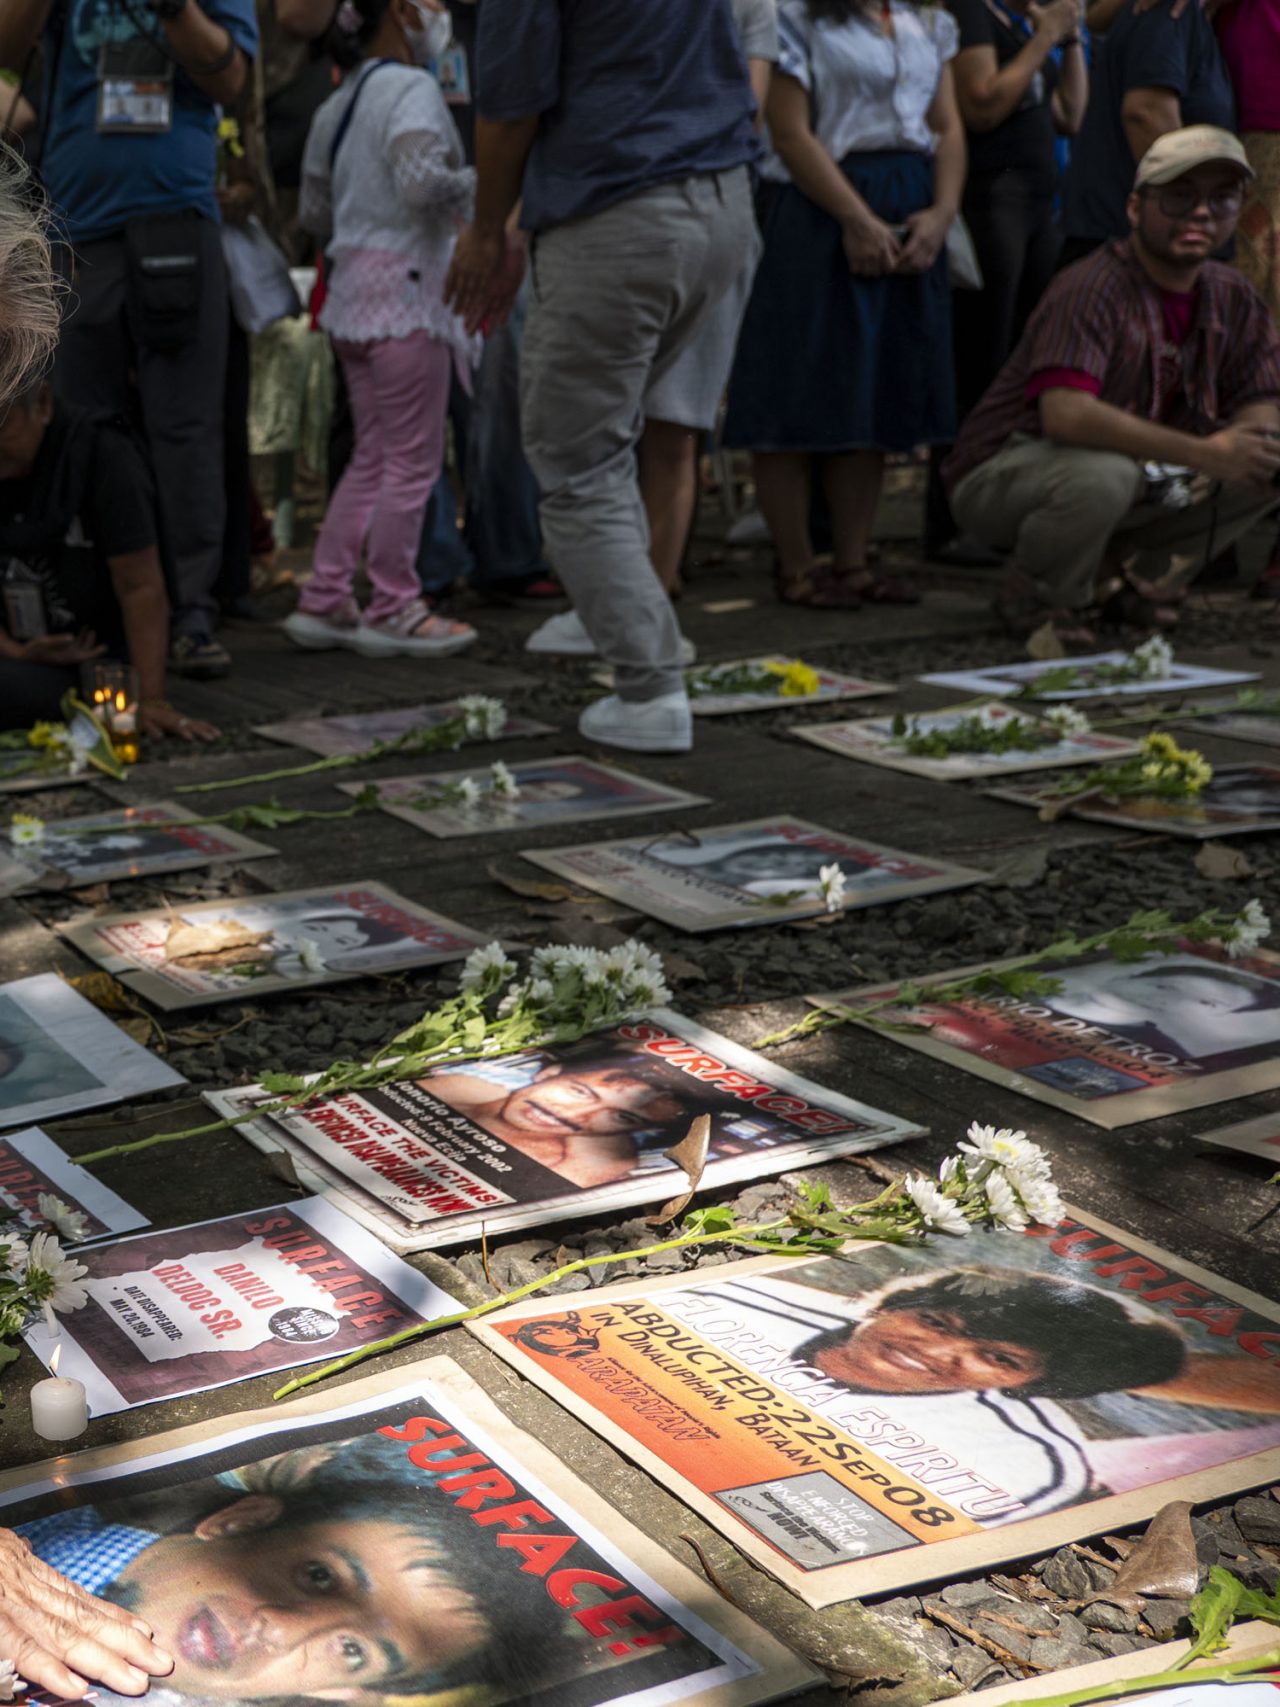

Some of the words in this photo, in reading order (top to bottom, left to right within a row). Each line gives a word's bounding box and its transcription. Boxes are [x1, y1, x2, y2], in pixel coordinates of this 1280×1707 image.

[1052, 1018, 1203, 1074] DETROZ
[618, 1025, 856, 1134] SURFACE!
[334, 1094, 399, 1139] URFACE
[391, 1136, 432, 1161] THE
[424, 1158, 506, 1207] VICTIMS!
[401, 1118, 438, 1143] Nueva
[434, 1141, 467, 1162] Ecija
[428, 1120, 482, 1154] February
[477, 1153, 513, 1173] 2002
[446, 1116, 507, 1153] Ayroso
[213, 1262, 285, 1310] DANILO
[243, 1215, 406, 1330] SURFACE
[109, 1298, 132, 1318] MAY
[122, 1285, 148, 1308] DATE
[138, 1297, 185, 1341] DISAPPEARED:
[151, 1263, 222, 1312] DELDOC
[198, 1308, 244, 1340] SR.
[276, 1321, 298, 1337] 1984
[658, 1297, 851, 1408] FLORENCIA
[827, 1404, 1026, 1519] ESPIRITU
[376, 1416, 687, 1657] SURFACE!
[799, 1488, 869, 1537] ENFORCED
[836, 1496, 875, 1523] STOP
